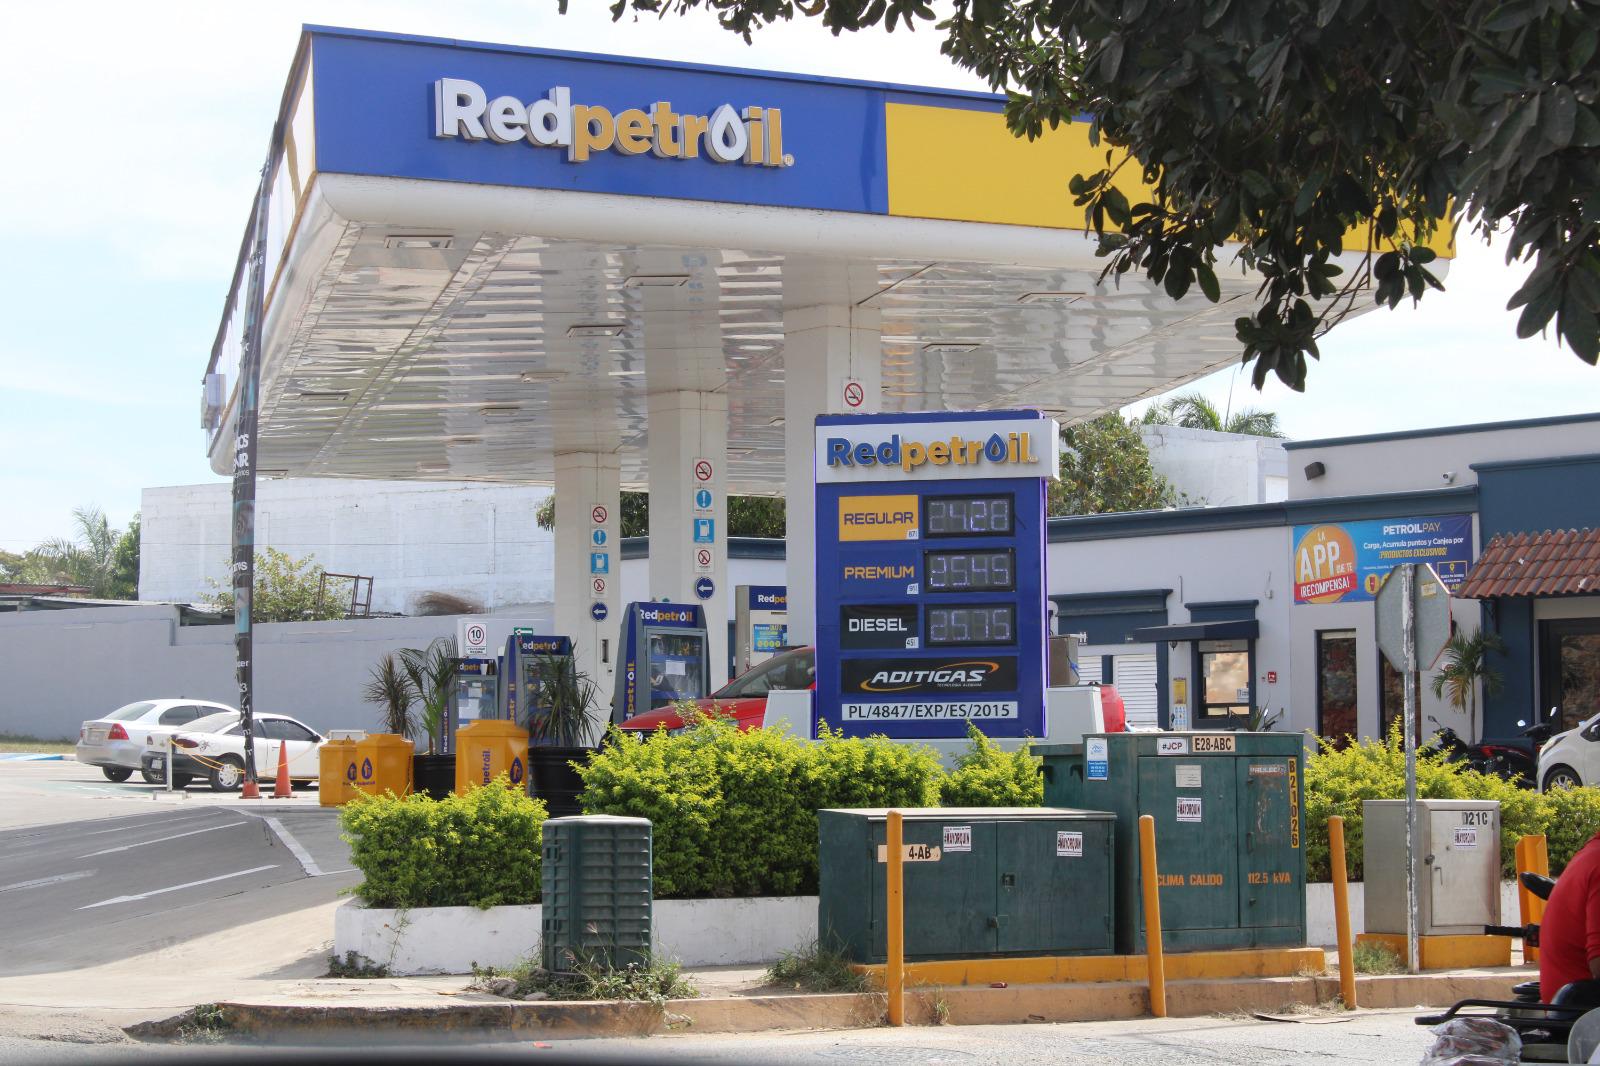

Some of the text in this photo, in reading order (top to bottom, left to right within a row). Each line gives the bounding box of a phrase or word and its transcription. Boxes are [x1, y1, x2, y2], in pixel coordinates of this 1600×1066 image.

[844, 512, 914, 525] REGULAR
[1317, 531, 1326, 541] LA
[1383, 539, 1407, 548] Acumula
[1407, 538, 1427, 547] puntos
[1453, 537, 1465, 545] por
[1300, 541, 1340, 582] APP
[844, 566, 915, 580] PREMIUM
[757, 594, 787, 604] Redpe
[848, 618, 908, 632] DIESEL
[471, 629, 481, 639] 10
[871, 669, 986, 683] ADITIGAS
[848, 704, 1010, 718] PL/4847/EXP/ES/2015
[1162, 742, 1183, 751] #JCP
[1194, 737, 1232, 751] E28-ABC
[482, 750, 491, 786] petroil
[908, 846, 932, 860] 4-AB
[1156, 874, 1223, 887] CLIMA CALIDO
[1247, 872, 1292, 884] 112.5 kVA
